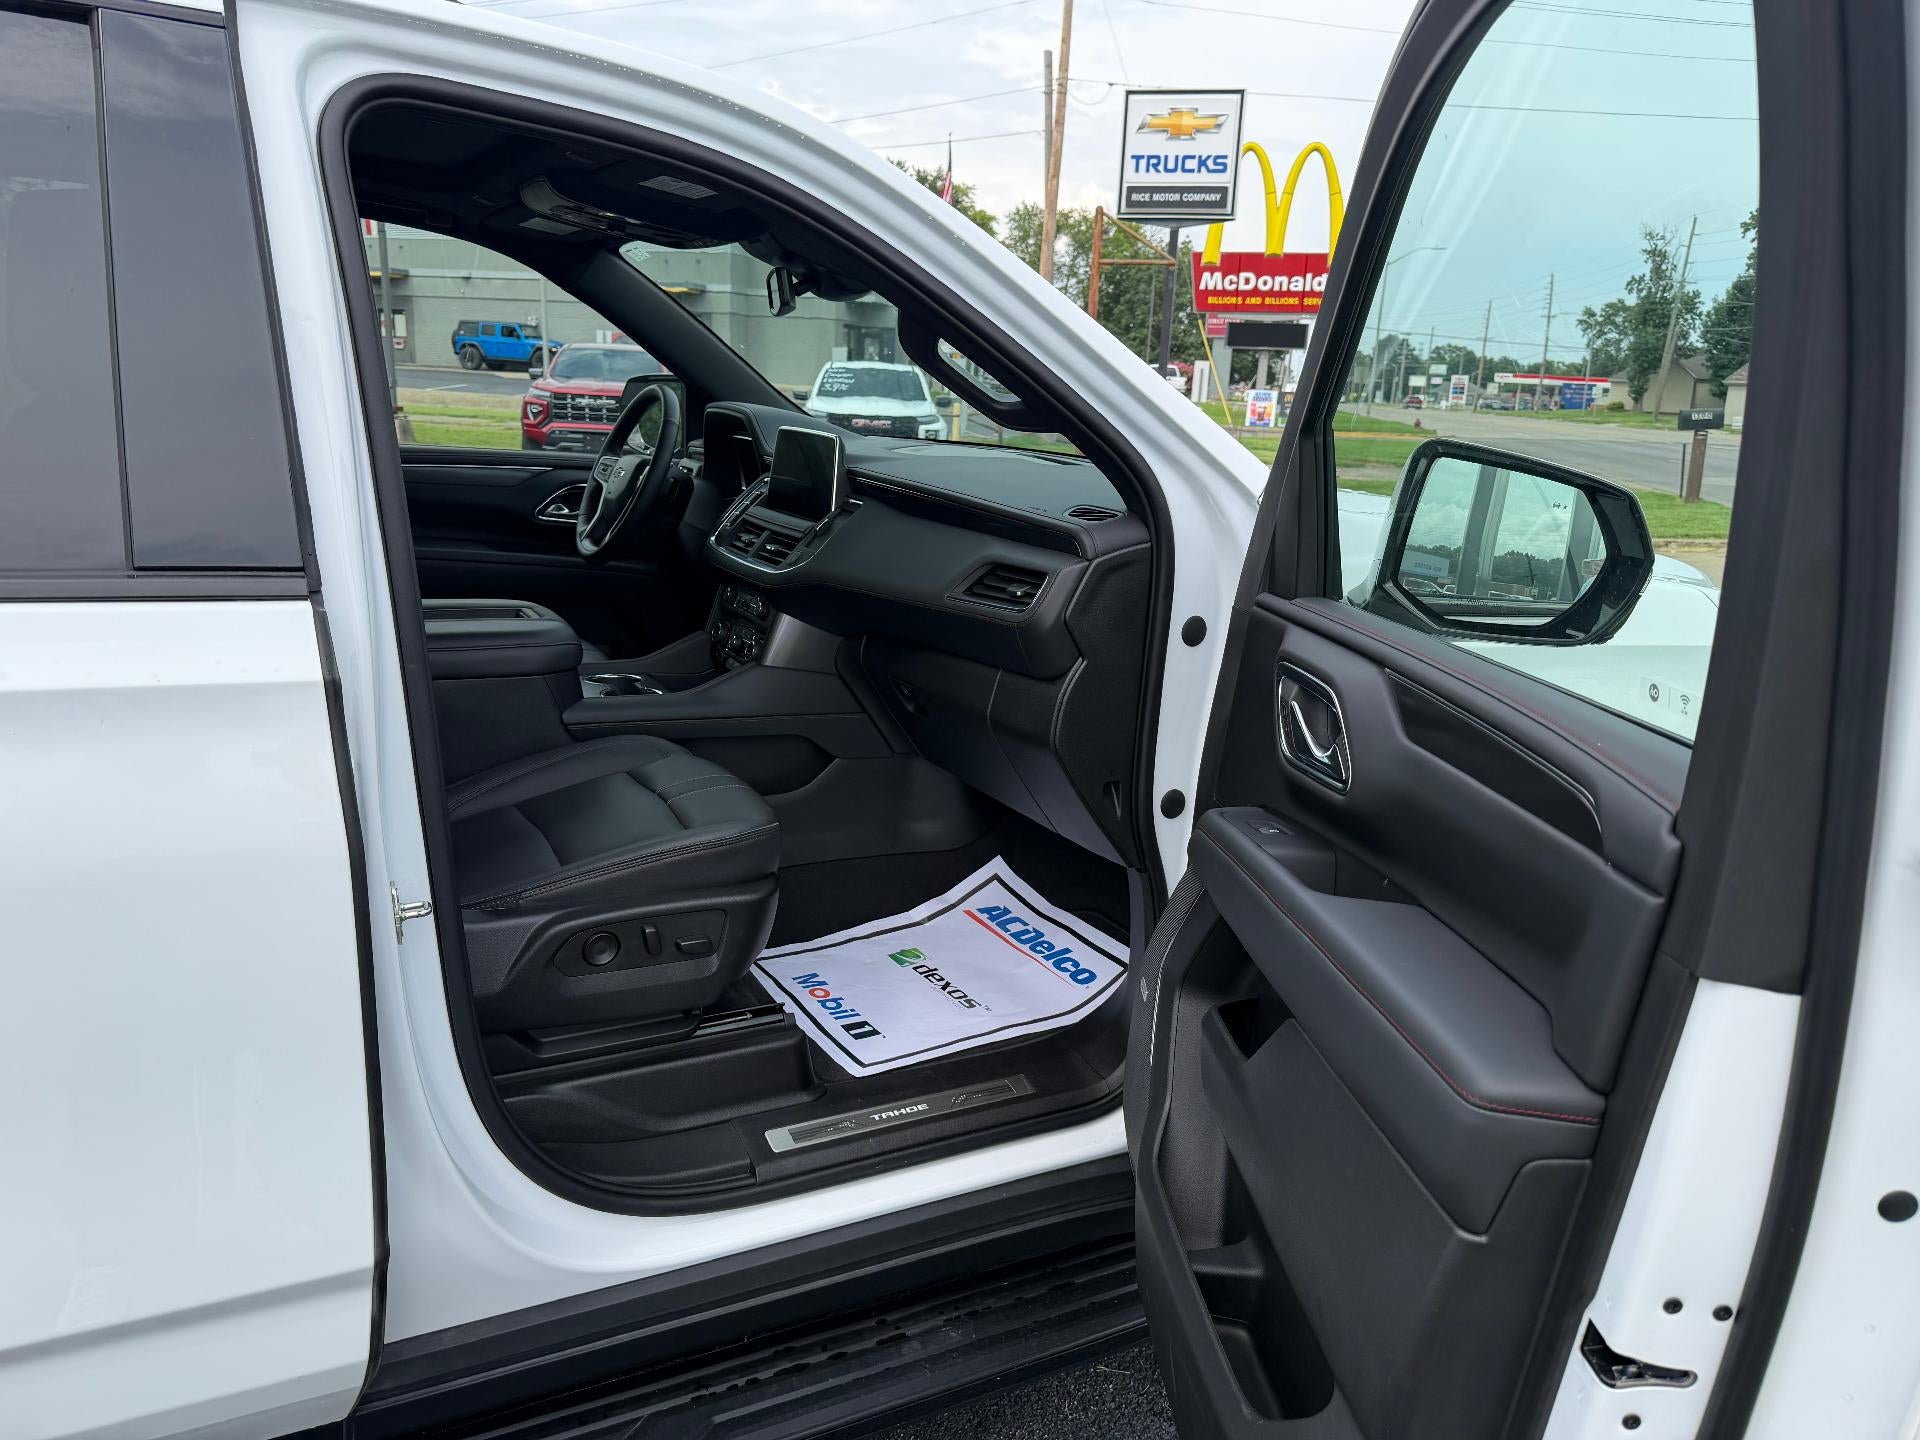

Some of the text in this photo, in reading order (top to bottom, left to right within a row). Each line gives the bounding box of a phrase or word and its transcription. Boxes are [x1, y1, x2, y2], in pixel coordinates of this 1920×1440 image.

[1130, 154, 1229, 174] TRUCKS
[1130, 193, 1222, 202] RICE MOTOR COMPANY
[1199, 271, 1329, 292] McDonald
[1207, 296, 1322, 306] BILLIONS AND BILLIONS SERV
[976, 905, 1097, 985] ACDelco
[792, 972, 861, 1020] Mobil
[912, 964, 982, 1009] dexos
[870, 1103, 929, 1121] TAHOE
